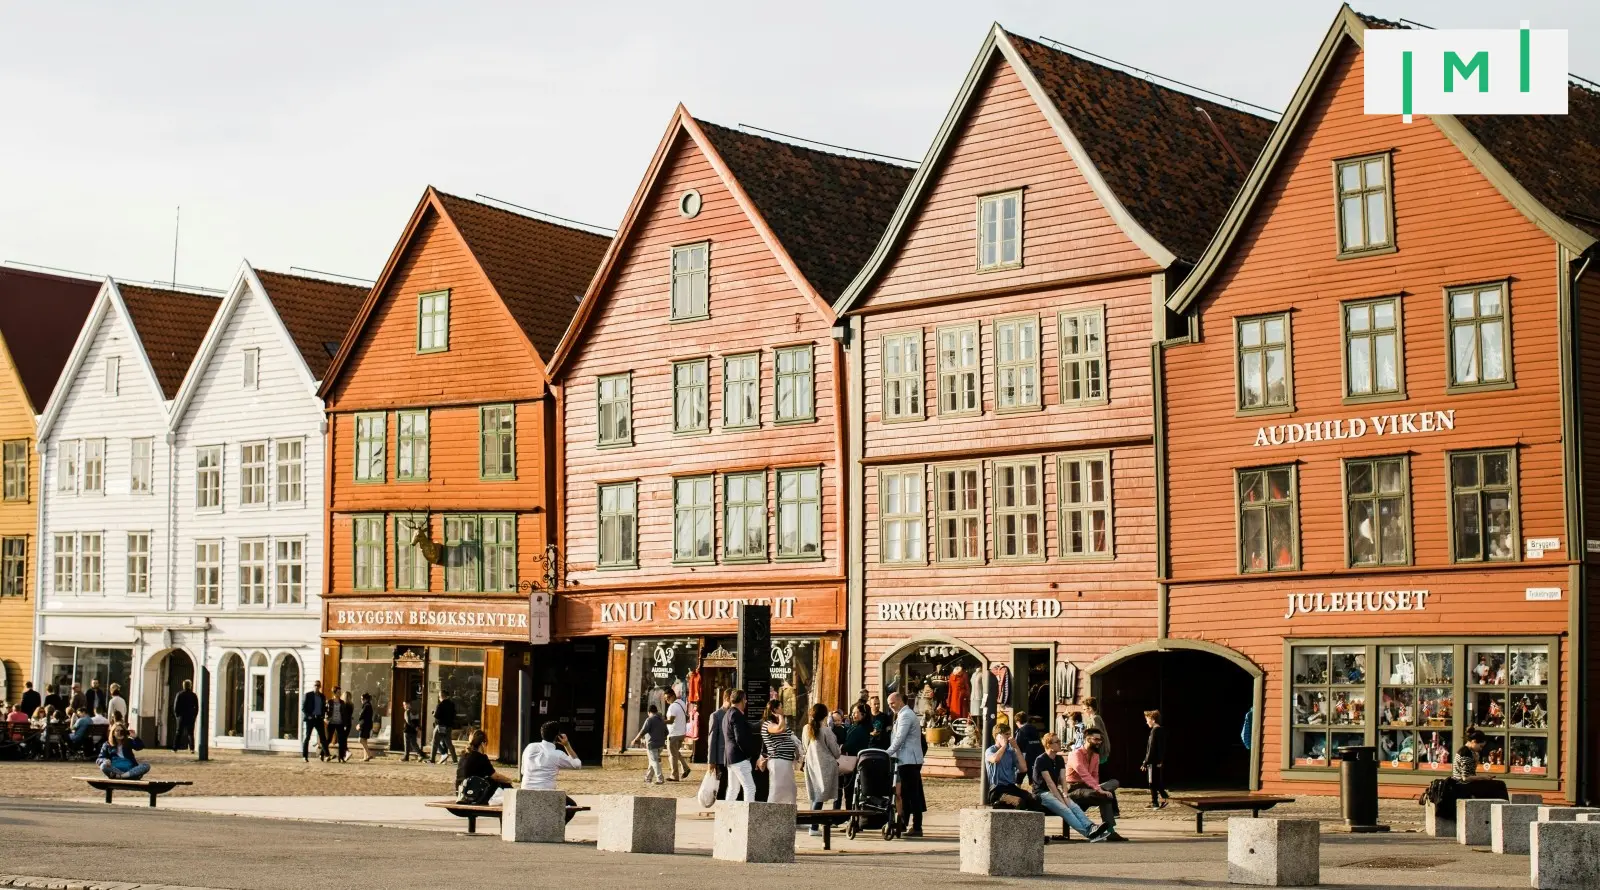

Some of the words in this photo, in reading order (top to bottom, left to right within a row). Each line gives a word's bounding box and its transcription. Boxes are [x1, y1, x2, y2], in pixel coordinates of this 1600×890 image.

[1253, 418, 1367, 447] AUDHILD
[1371, 409, 1455, 436] VIKEN
[1531, 540, 1556, 549] Bryggen
[600, 601, 656, 622] KNUT
[878, 600, 966, 621] BRYGGEN
[972, 598, 1063, 619] HUSFLID
[1285, 590, 1430, 619] JULEHUSET
[337, 610, 404, 625] BRYGGEN
[409, 611, 528, 627] BESØKSSENTER
